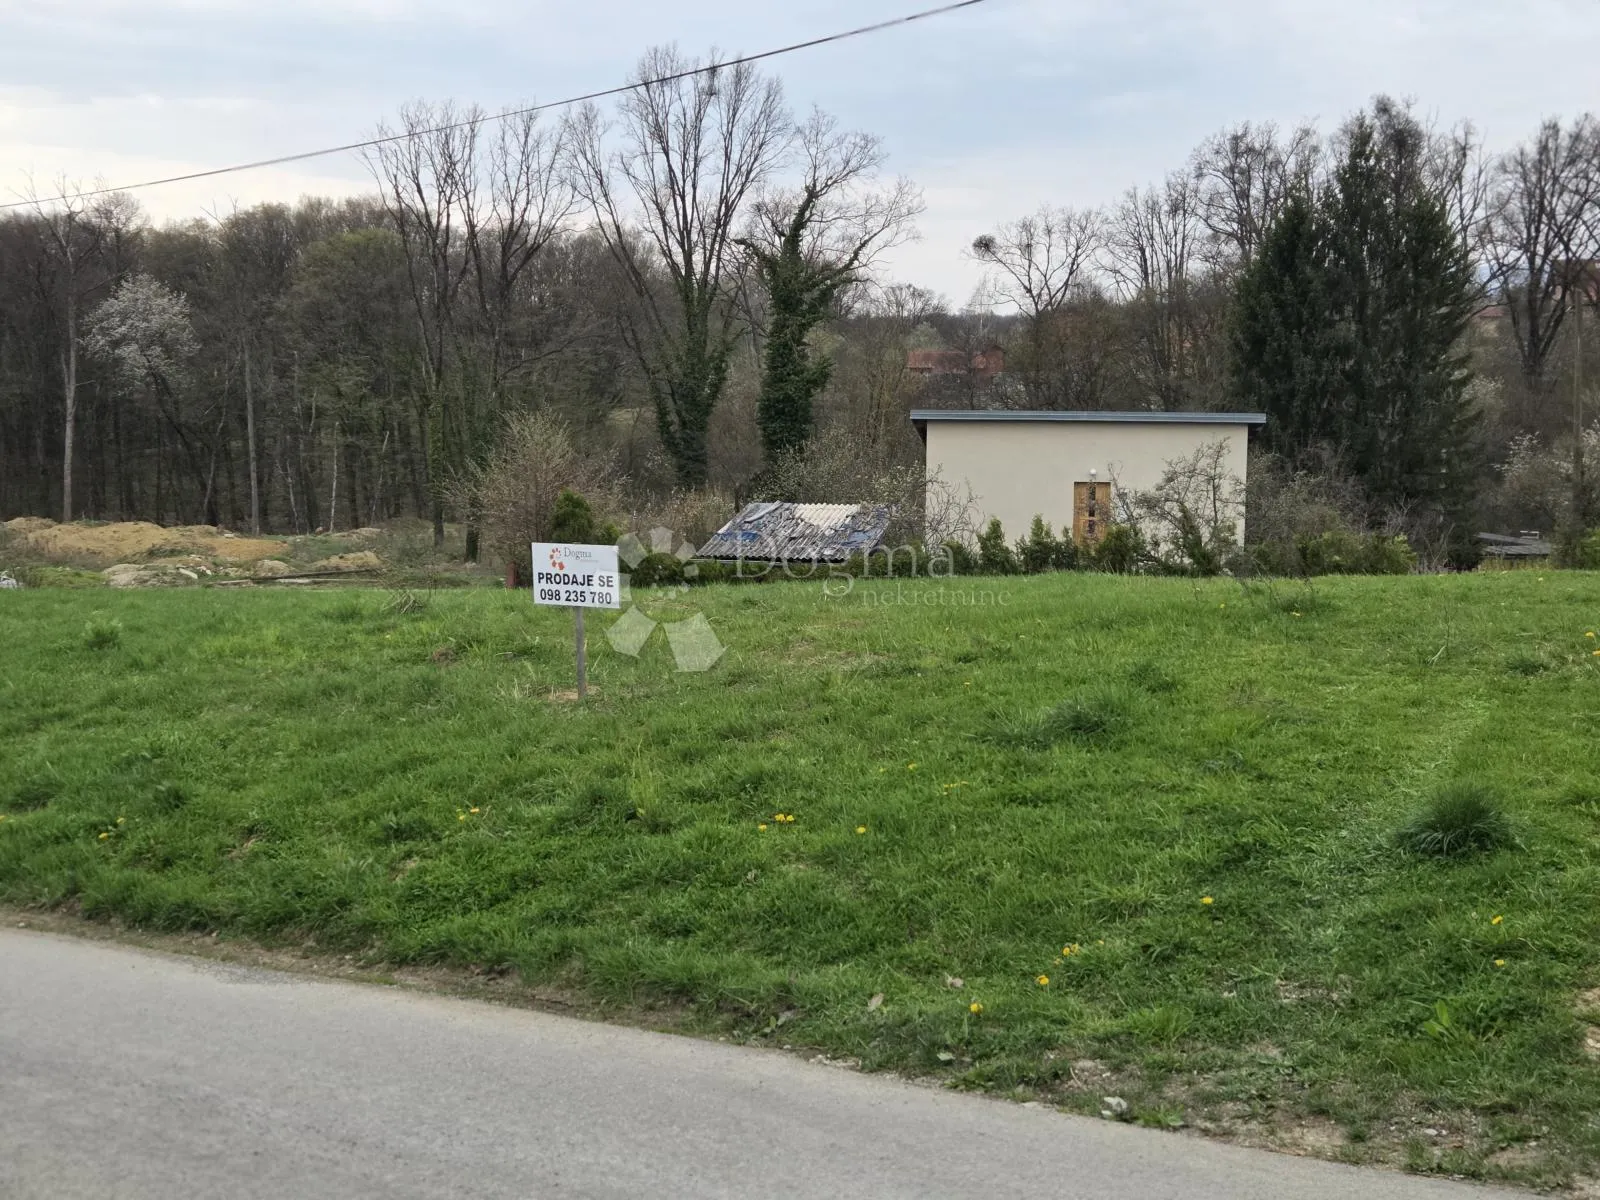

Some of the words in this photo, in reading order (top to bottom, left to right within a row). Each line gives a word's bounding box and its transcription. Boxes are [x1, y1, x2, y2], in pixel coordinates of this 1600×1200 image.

[564, 547, 592, 560] Dogma
[538, 572, 594, 587] PRODAJE
[598, 575, 614, 588] SE
[540, 588, 561, 601] 098
[565, 590, 586, 603] 235
[590, 591, 612, 604] 780
